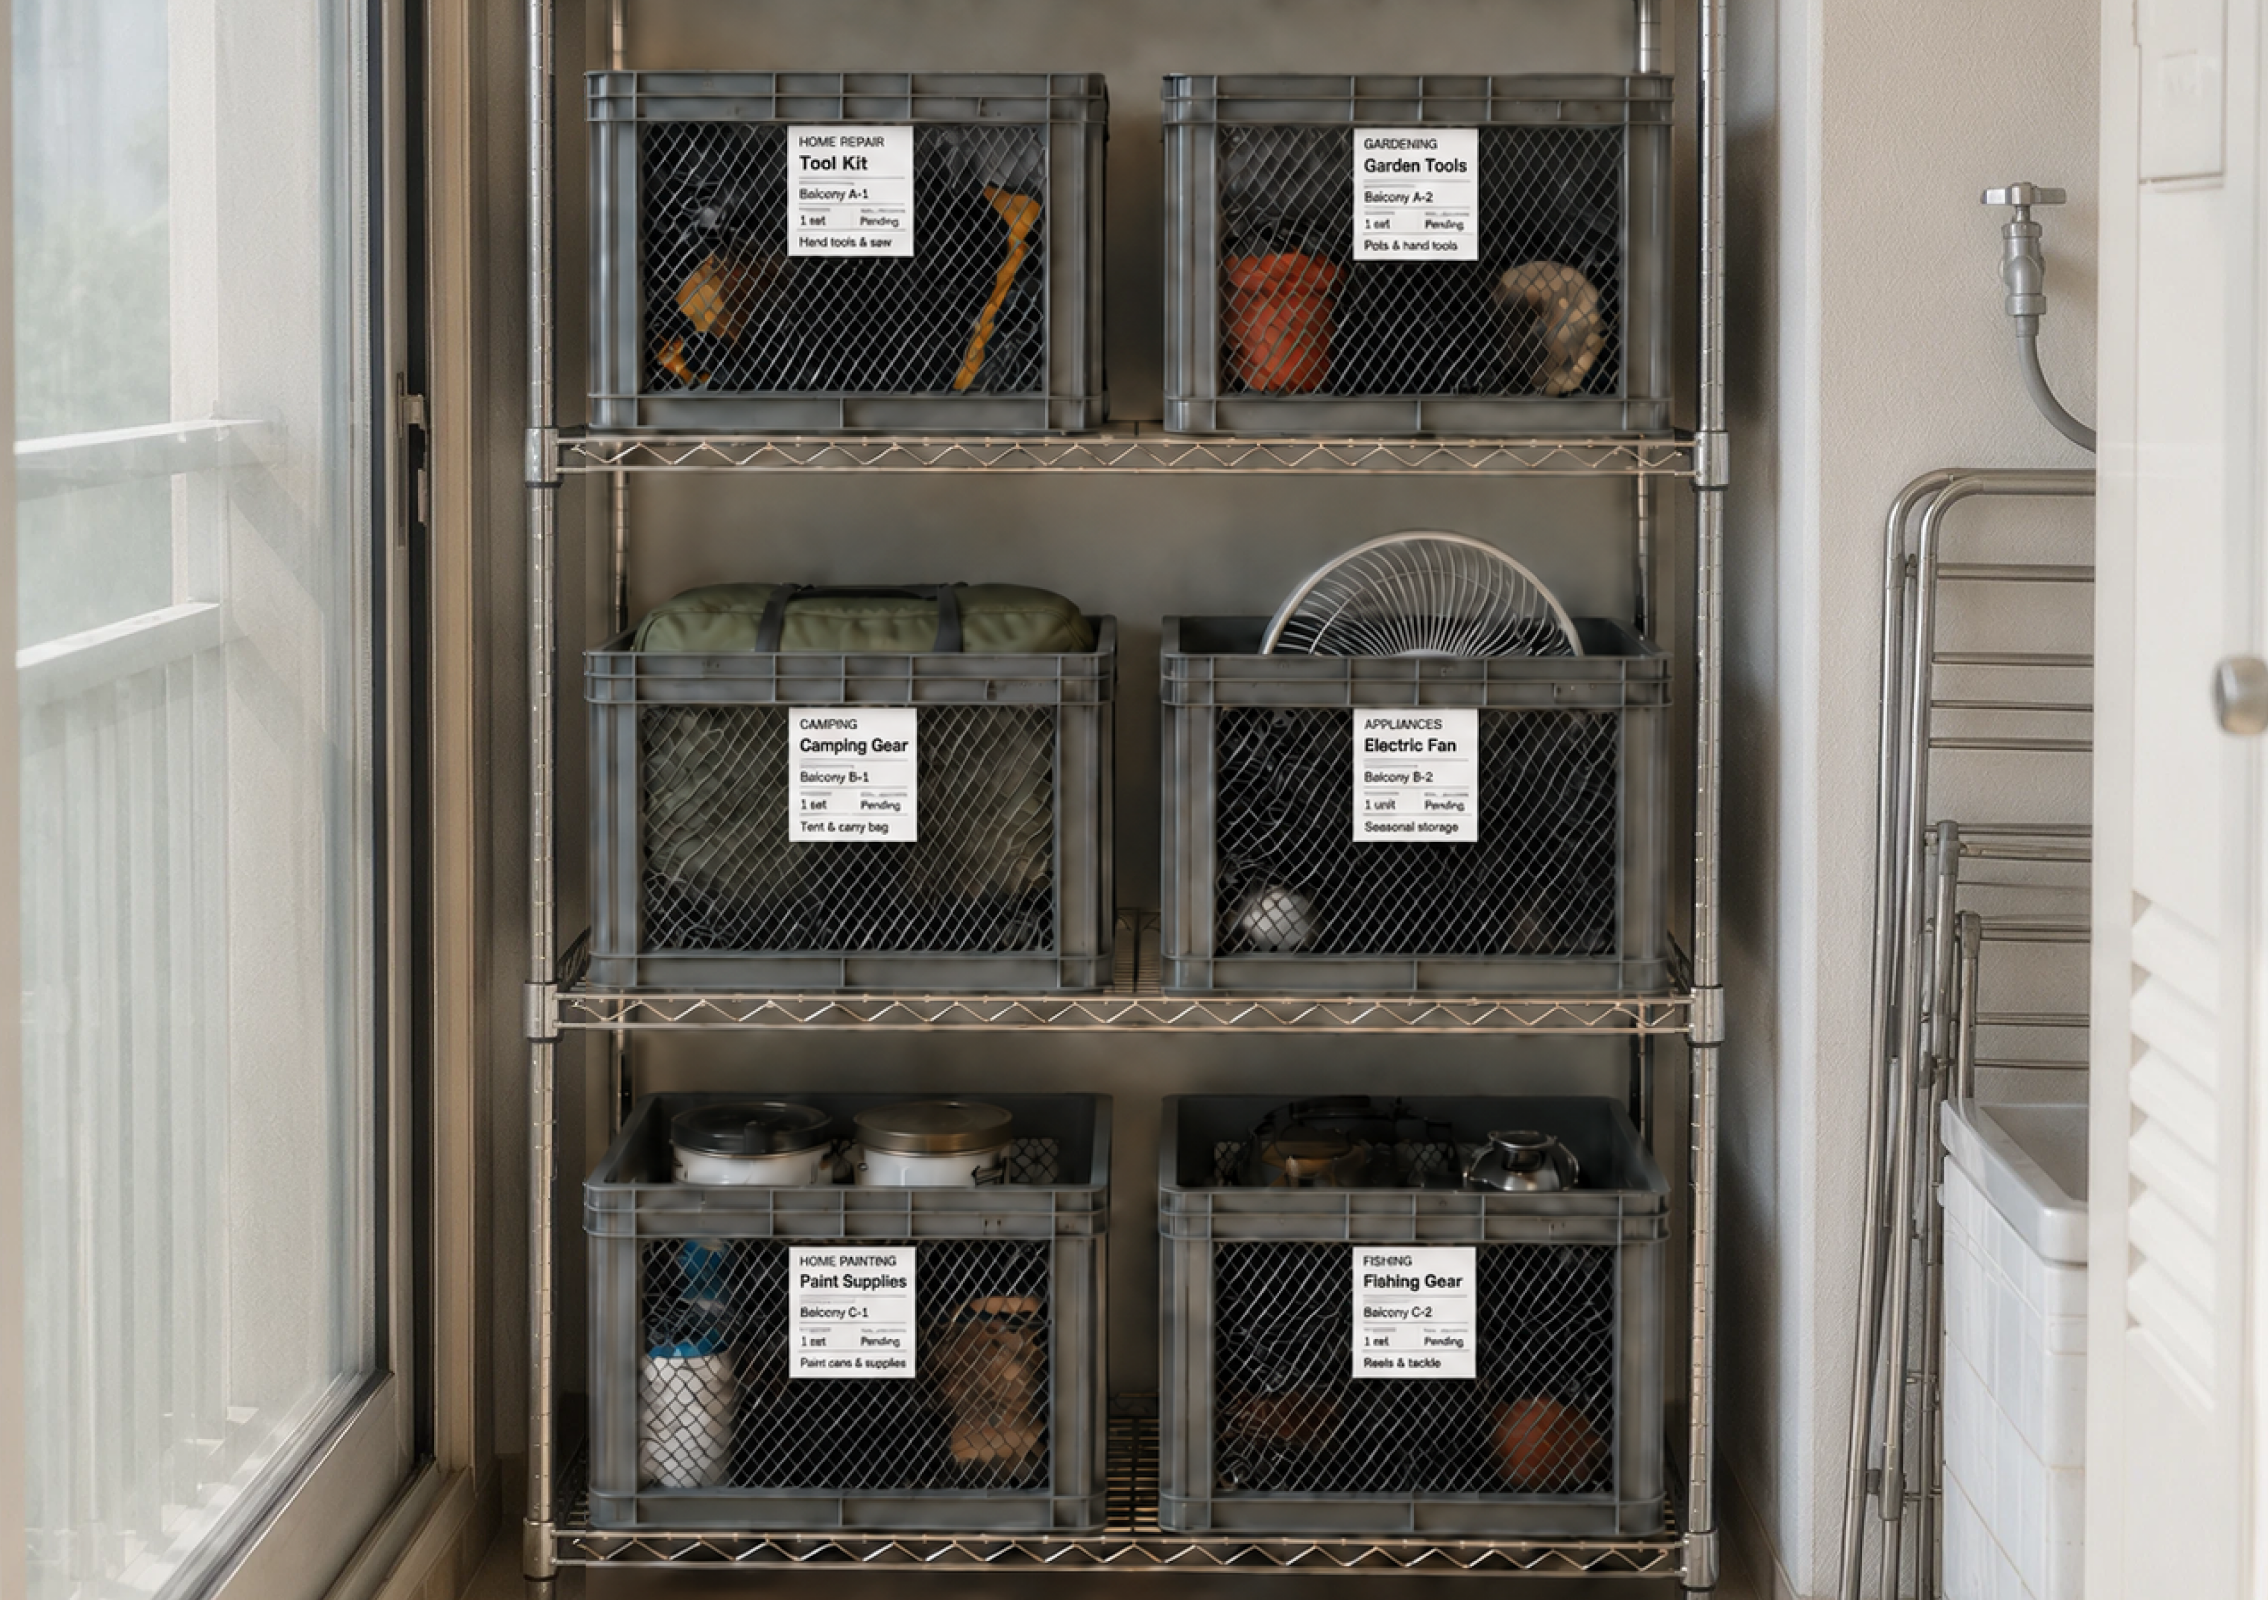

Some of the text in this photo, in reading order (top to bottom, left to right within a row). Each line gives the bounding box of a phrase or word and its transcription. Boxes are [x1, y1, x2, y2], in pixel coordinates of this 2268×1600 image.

[799, 136, 884, 147] HOME REPAIR
[1364, 138, 1438, 150] GARDENING
[799, 155, 867, 170] Tool Kit
[1364, 158, 1467, 172] Garden Tools
[849, 189, 868, 198] A-1
[1413, 191, 1433, 203] A-2
[800, 215, 806, 225] 1
[1365, 220, 1370, 229] 1
[859, 237, 867, 247] &
[1404, 241, 1429, 251] hand
[800, 719, 857, 729] CAMPING
[1365, 719, 1442, 729] APPLIANCES
[800, 738, 908, 755] Camping Gear
[1365, 738, 1456, 752] Electric Fan
[801, 772, 869, 784] Balcony B-1
[1414, 771, 1433, 782] B-2
[801, 799, 806, 809] 1
[1365, 800, 1395, 809] 1 unit
[801, 821, 824, 832] Tent
[828, 822, 835, 832] &
[1418, 823, 1458, 835] storage
[800, 1255, 896, 1267] HOME PAINTING
[1364, 1255, 1412, 1267] FISHING
[801, 1274, 907, 1291] Paint Supplies
[1364, 1274, 1463, 1291] Fishing Gear
[848, 1307, 868, 1317] C-1
[1412, 1306, 1432, 1317] C-2
[801, 1337, 806, 1346] 1
[1365, 1337, 1369, 1346] 1
